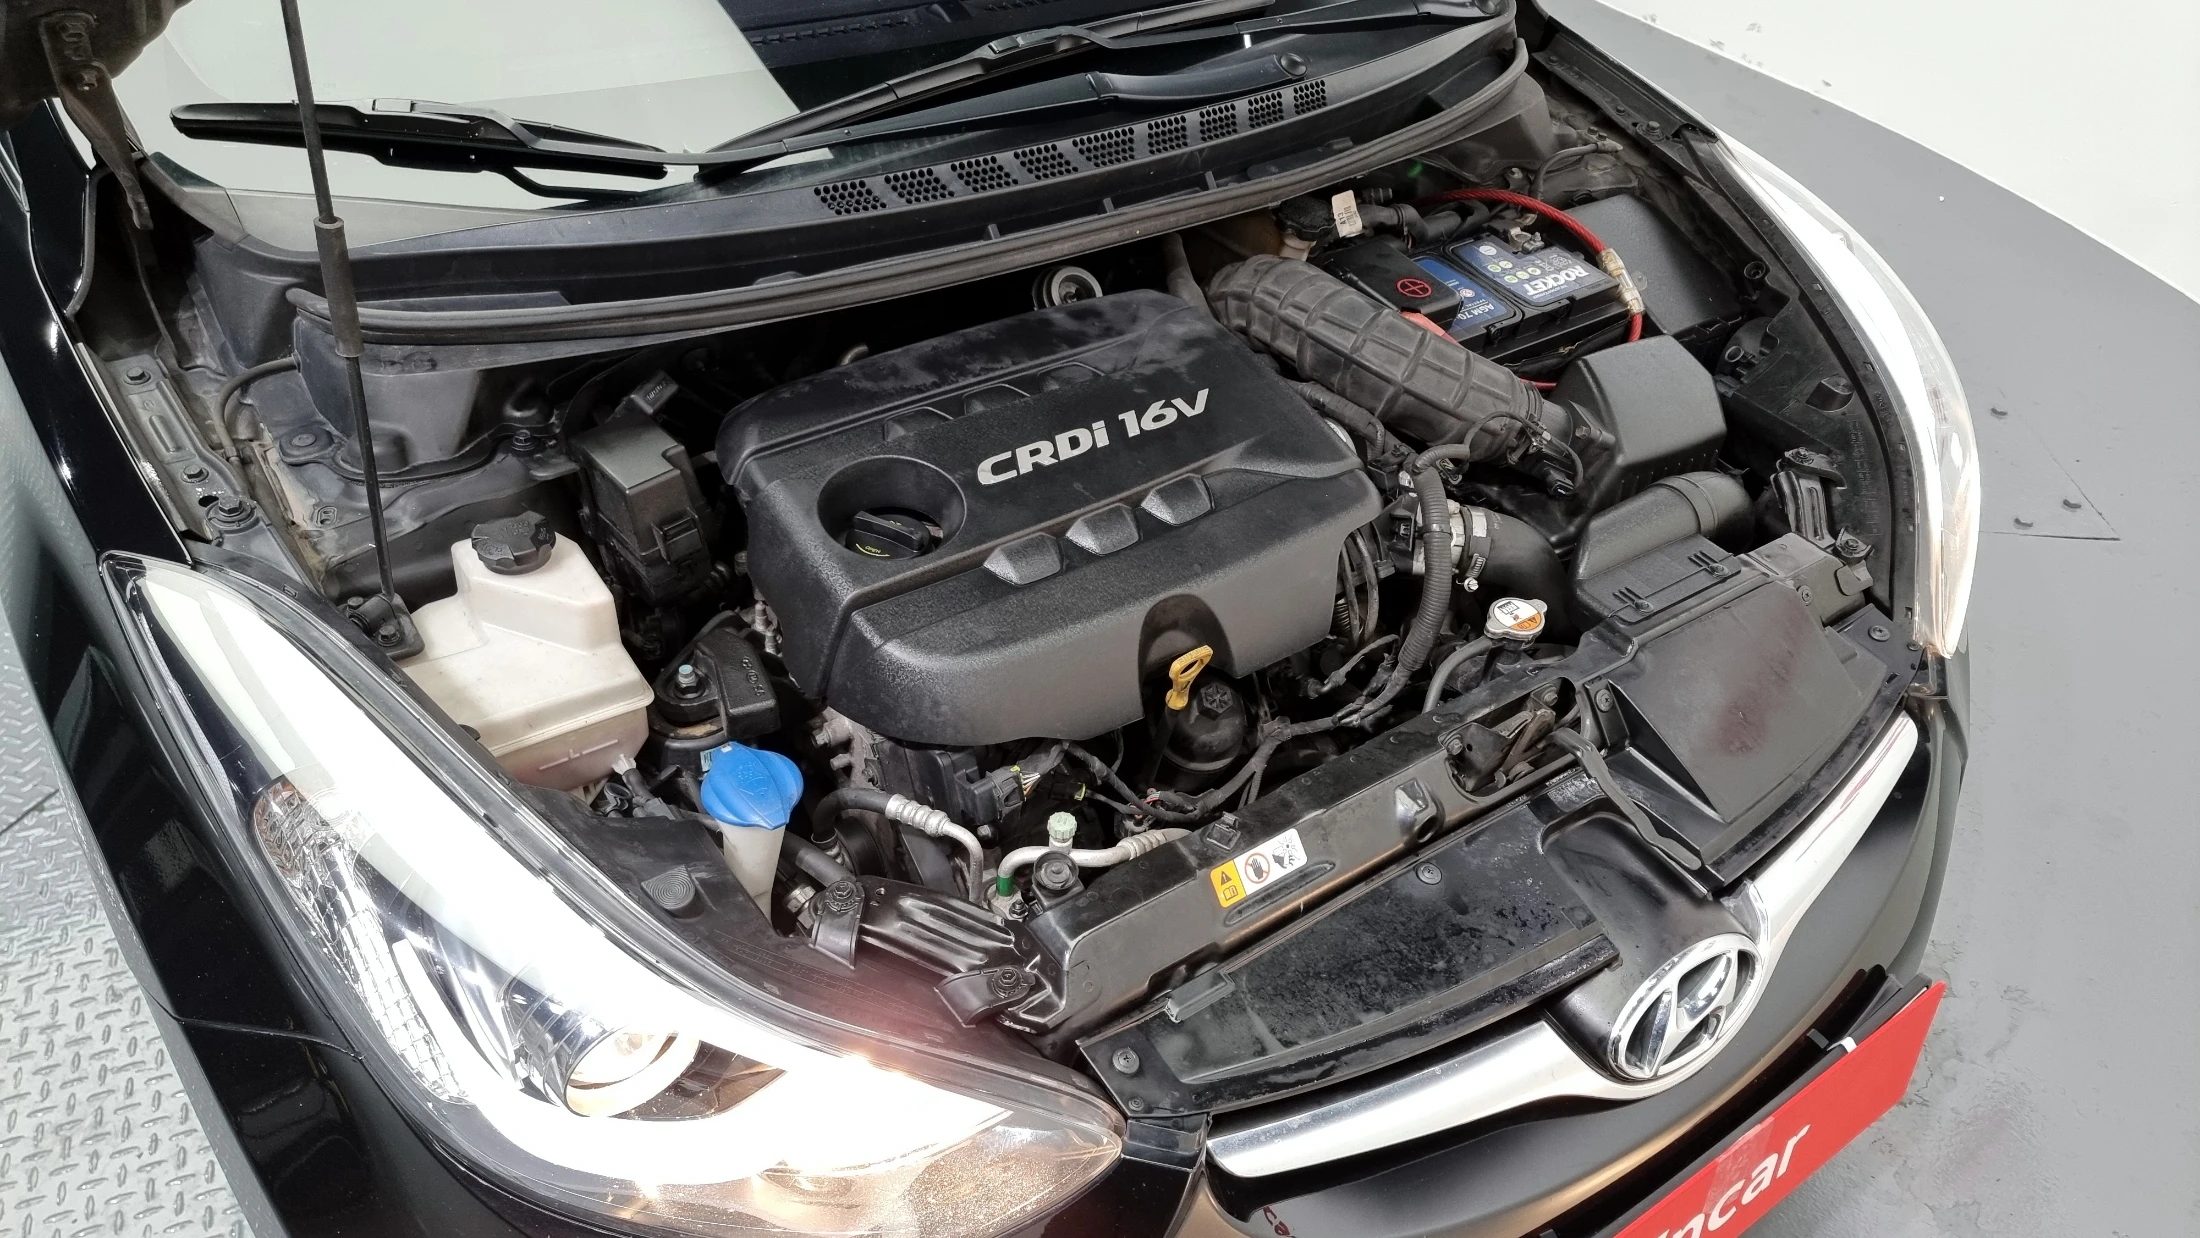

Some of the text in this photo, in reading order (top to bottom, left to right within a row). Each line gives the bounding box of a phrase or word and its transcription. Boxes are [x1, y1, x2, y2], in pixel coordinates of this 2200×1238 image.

[1337, 211, 1347, 225] A13
[1522, 265, 1591, 296] ROCKET
[1470, 303, 1495, 316] AGM
[977, 387, 1211, 486] CRDi 16V
[865, 545, 882, 554] OPEN
[1656, 1123, 1812, 1238] ncar
